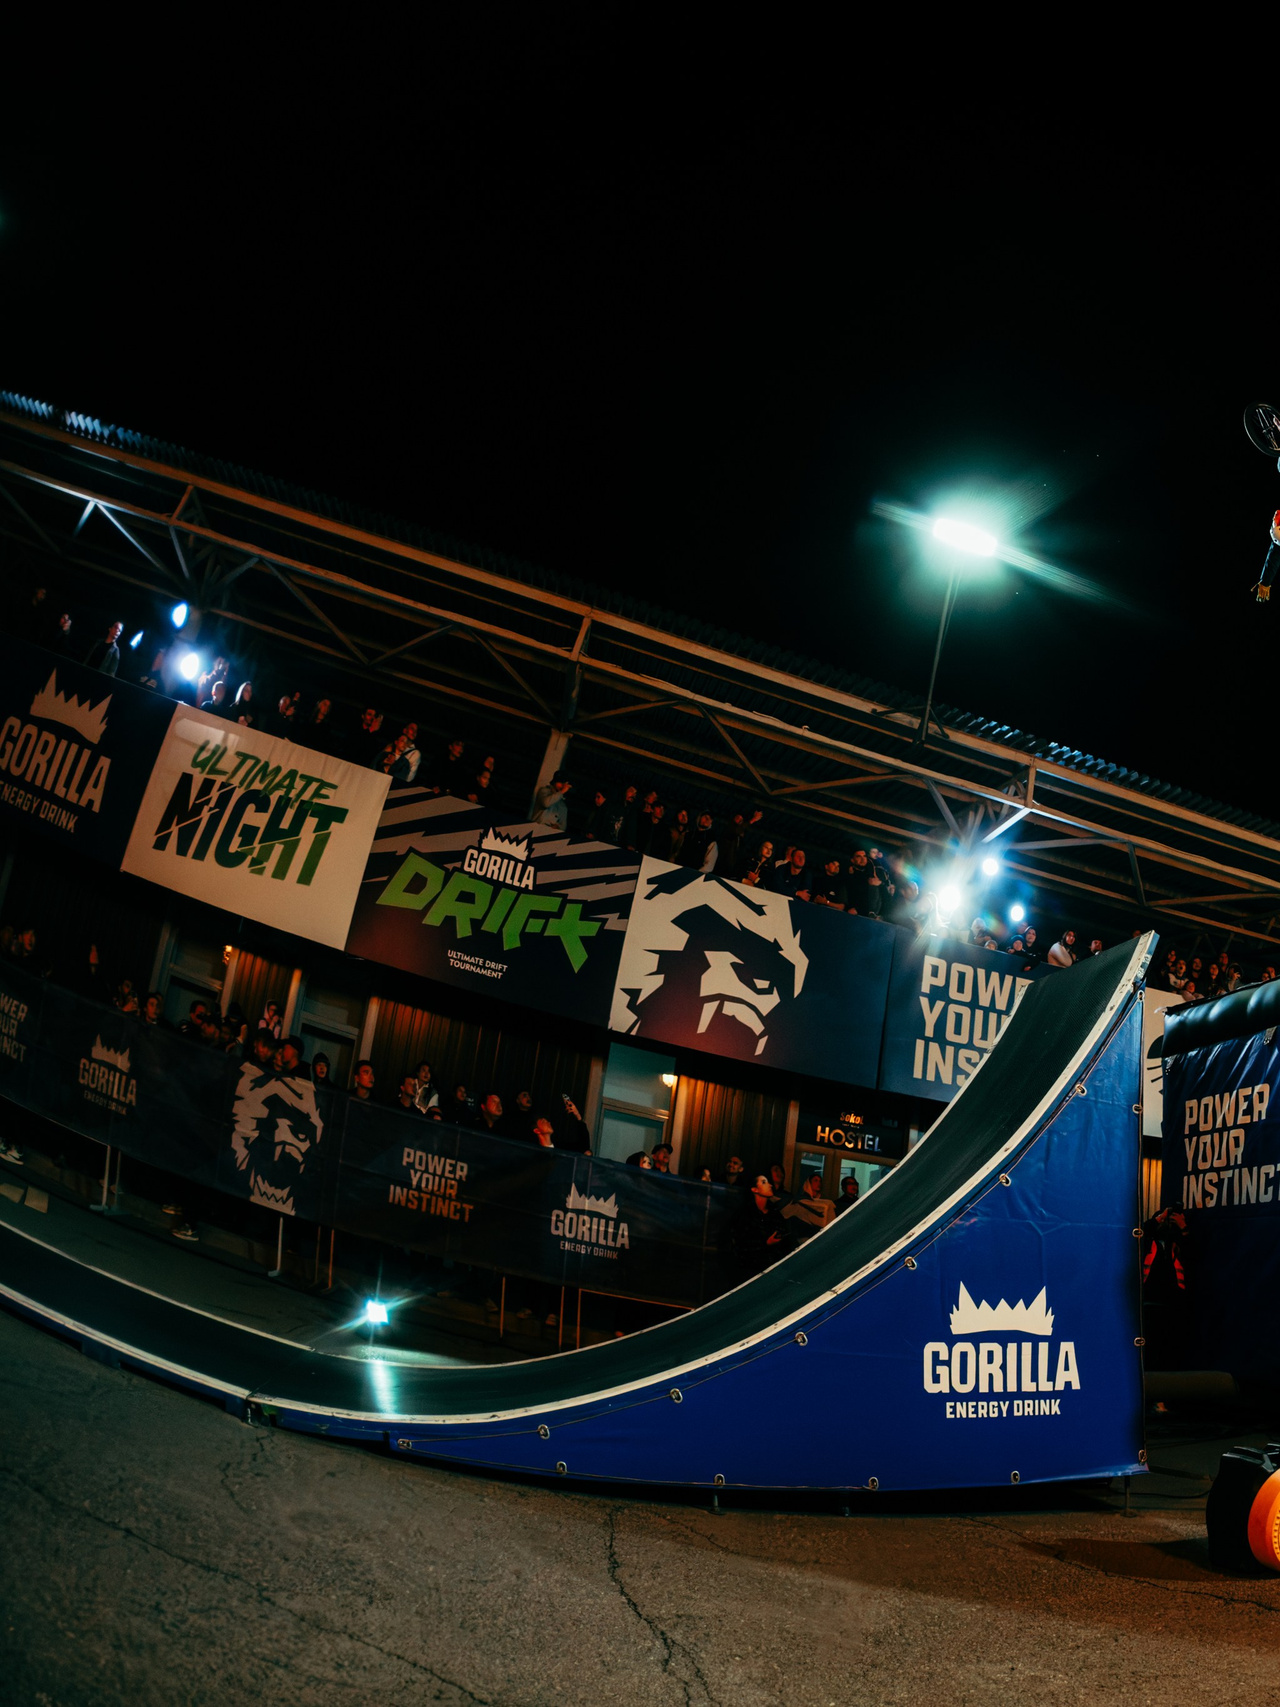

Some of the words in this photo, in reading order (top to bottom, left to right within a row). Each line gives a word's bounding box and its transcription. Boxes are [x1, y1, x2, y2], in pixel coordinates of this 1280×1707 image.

[0, 716, 111, 813] GORILLA
[191, 740, 338, 810] ULTIMATE
[39, 800, 78, 833] DRINK
[152, 772, 349, 886] NIGHT
[463, 848, 535, 890] GORILLA
[375, 852, 602, 973] DRIFT
[447, 949, 485, 966] ULTIMATE
[485, 960, 508, 972] DRIFT
[449, 958, 503, 979] TOURNAMENT
[919, 996, 1011, 1049] YOU
[78, 1057, 137, 1107] GORILLA
[1184, 1083, 1270, 1135] POWER
[816, 1125, 882, 1152] HOSTEL
[1184, 1128, 1245, 1172] YOUR
[402, 1147, 469, 1181] POWER
[410, 1169, 458, 1199] YOUR
[389, 1184, 474, 1223] INSTINCT
[550, 1209, 630, 1250] GORILLA
[560, 1240, 592, 1255] ENERGY
[593, 1246, 618, 1260] DRINK
[923, 1341, 1081, 1393] GORILLA
[946, 1401, 1009, 1419] ENERGY
[1014, 1399, 1061, 1417] DRINK
